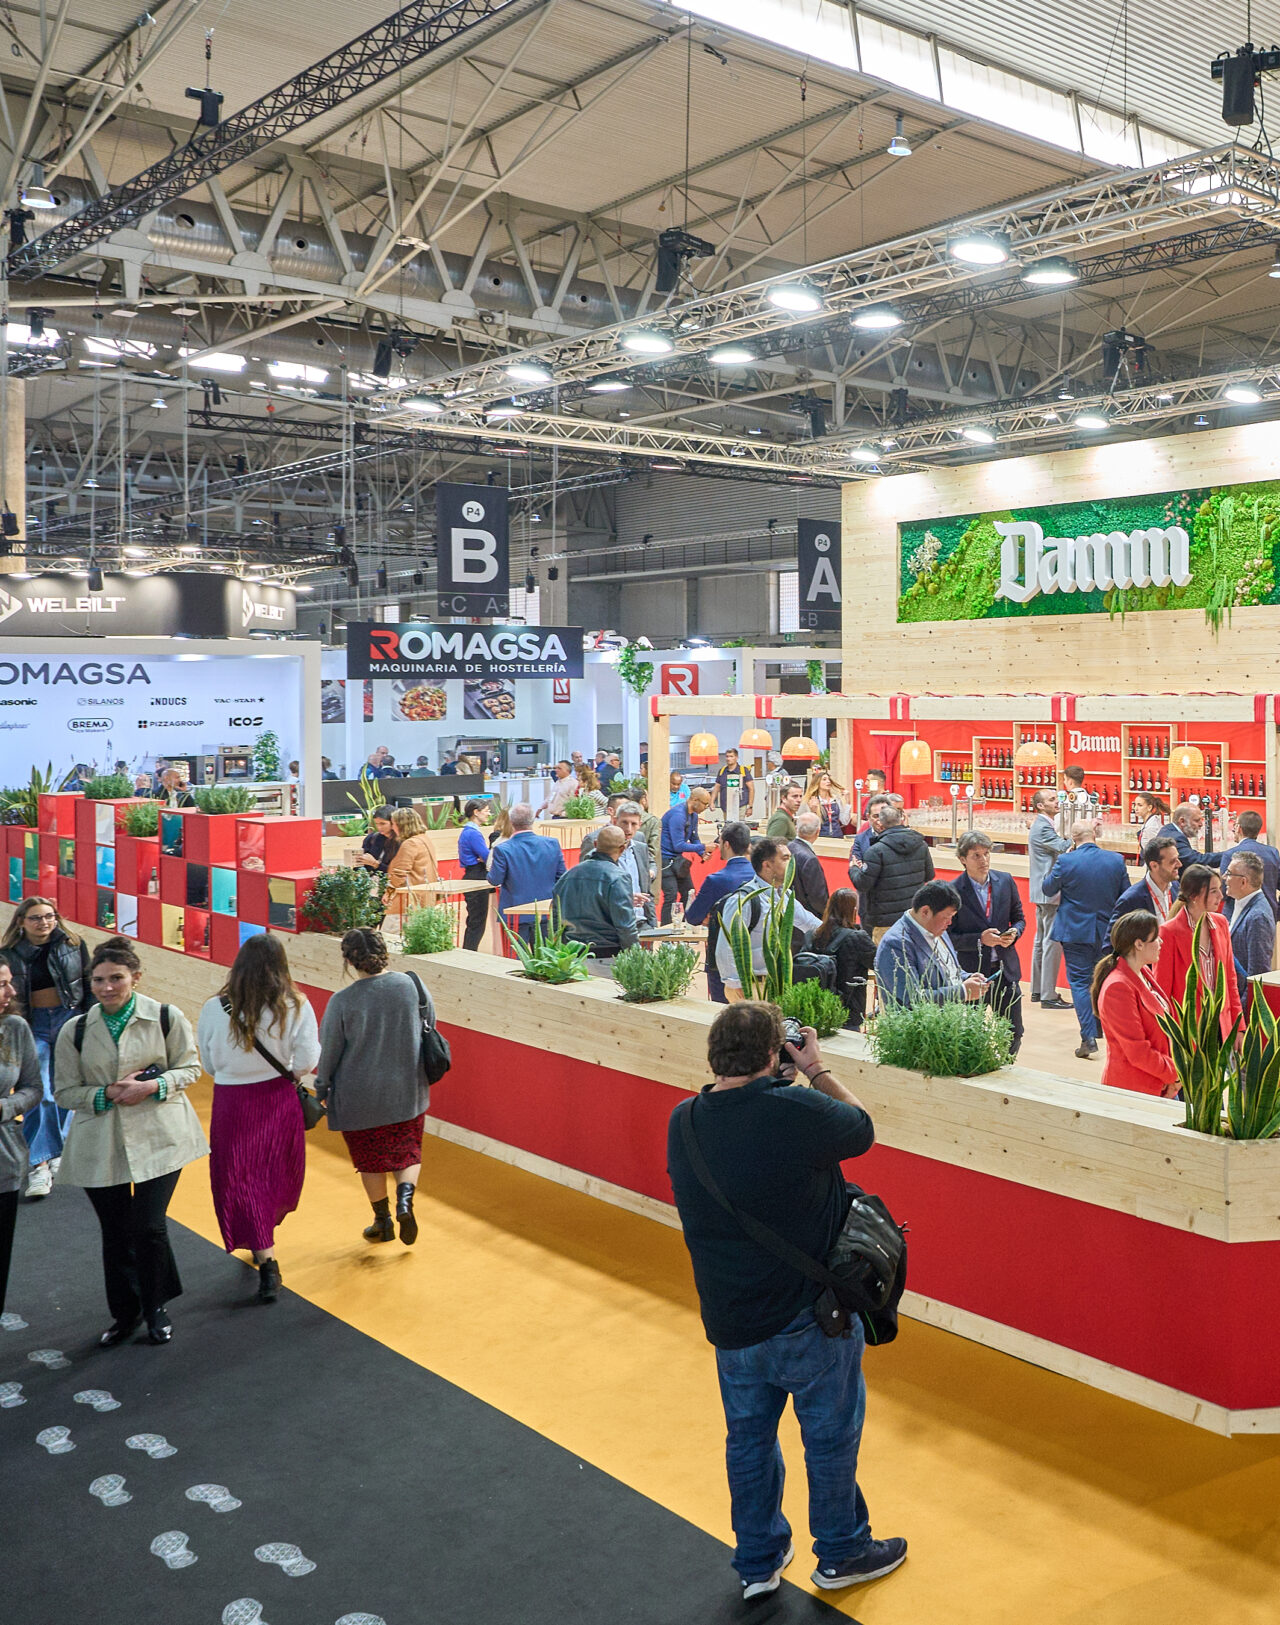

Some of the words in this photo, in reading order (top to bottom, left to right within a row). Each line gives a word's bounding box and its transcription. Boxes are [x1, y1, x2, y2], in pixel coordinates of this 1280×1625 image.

[466, 507, 480, 516] P4
[817, 538, 828, 547] P4
[451, 527, 499, 583] B
[993, 520, 1194, 603] Damm
[806, 556, 842, 603] A
[26, 597, 118, 613] WELBILT
[254, 603, 286, 621] WELBILT
[451, 595, 467, 613] C
[485, 597, 500, 614] A
[808, 612, 818, 627] B
[369, 629, 568, 661] ROMAGSA
[369, 663, 458, 673] MAQUINARIA
[465, 663, 483, 673] DE
[490, 661, 567, 673] HOSTELERÍA
[88, 697, 125, 705] SILANOS
[72, 721, 109, 729] BREMA
[228, 716, 263, 727] ICOS
[1068, 729, 1121, 754] Damm
